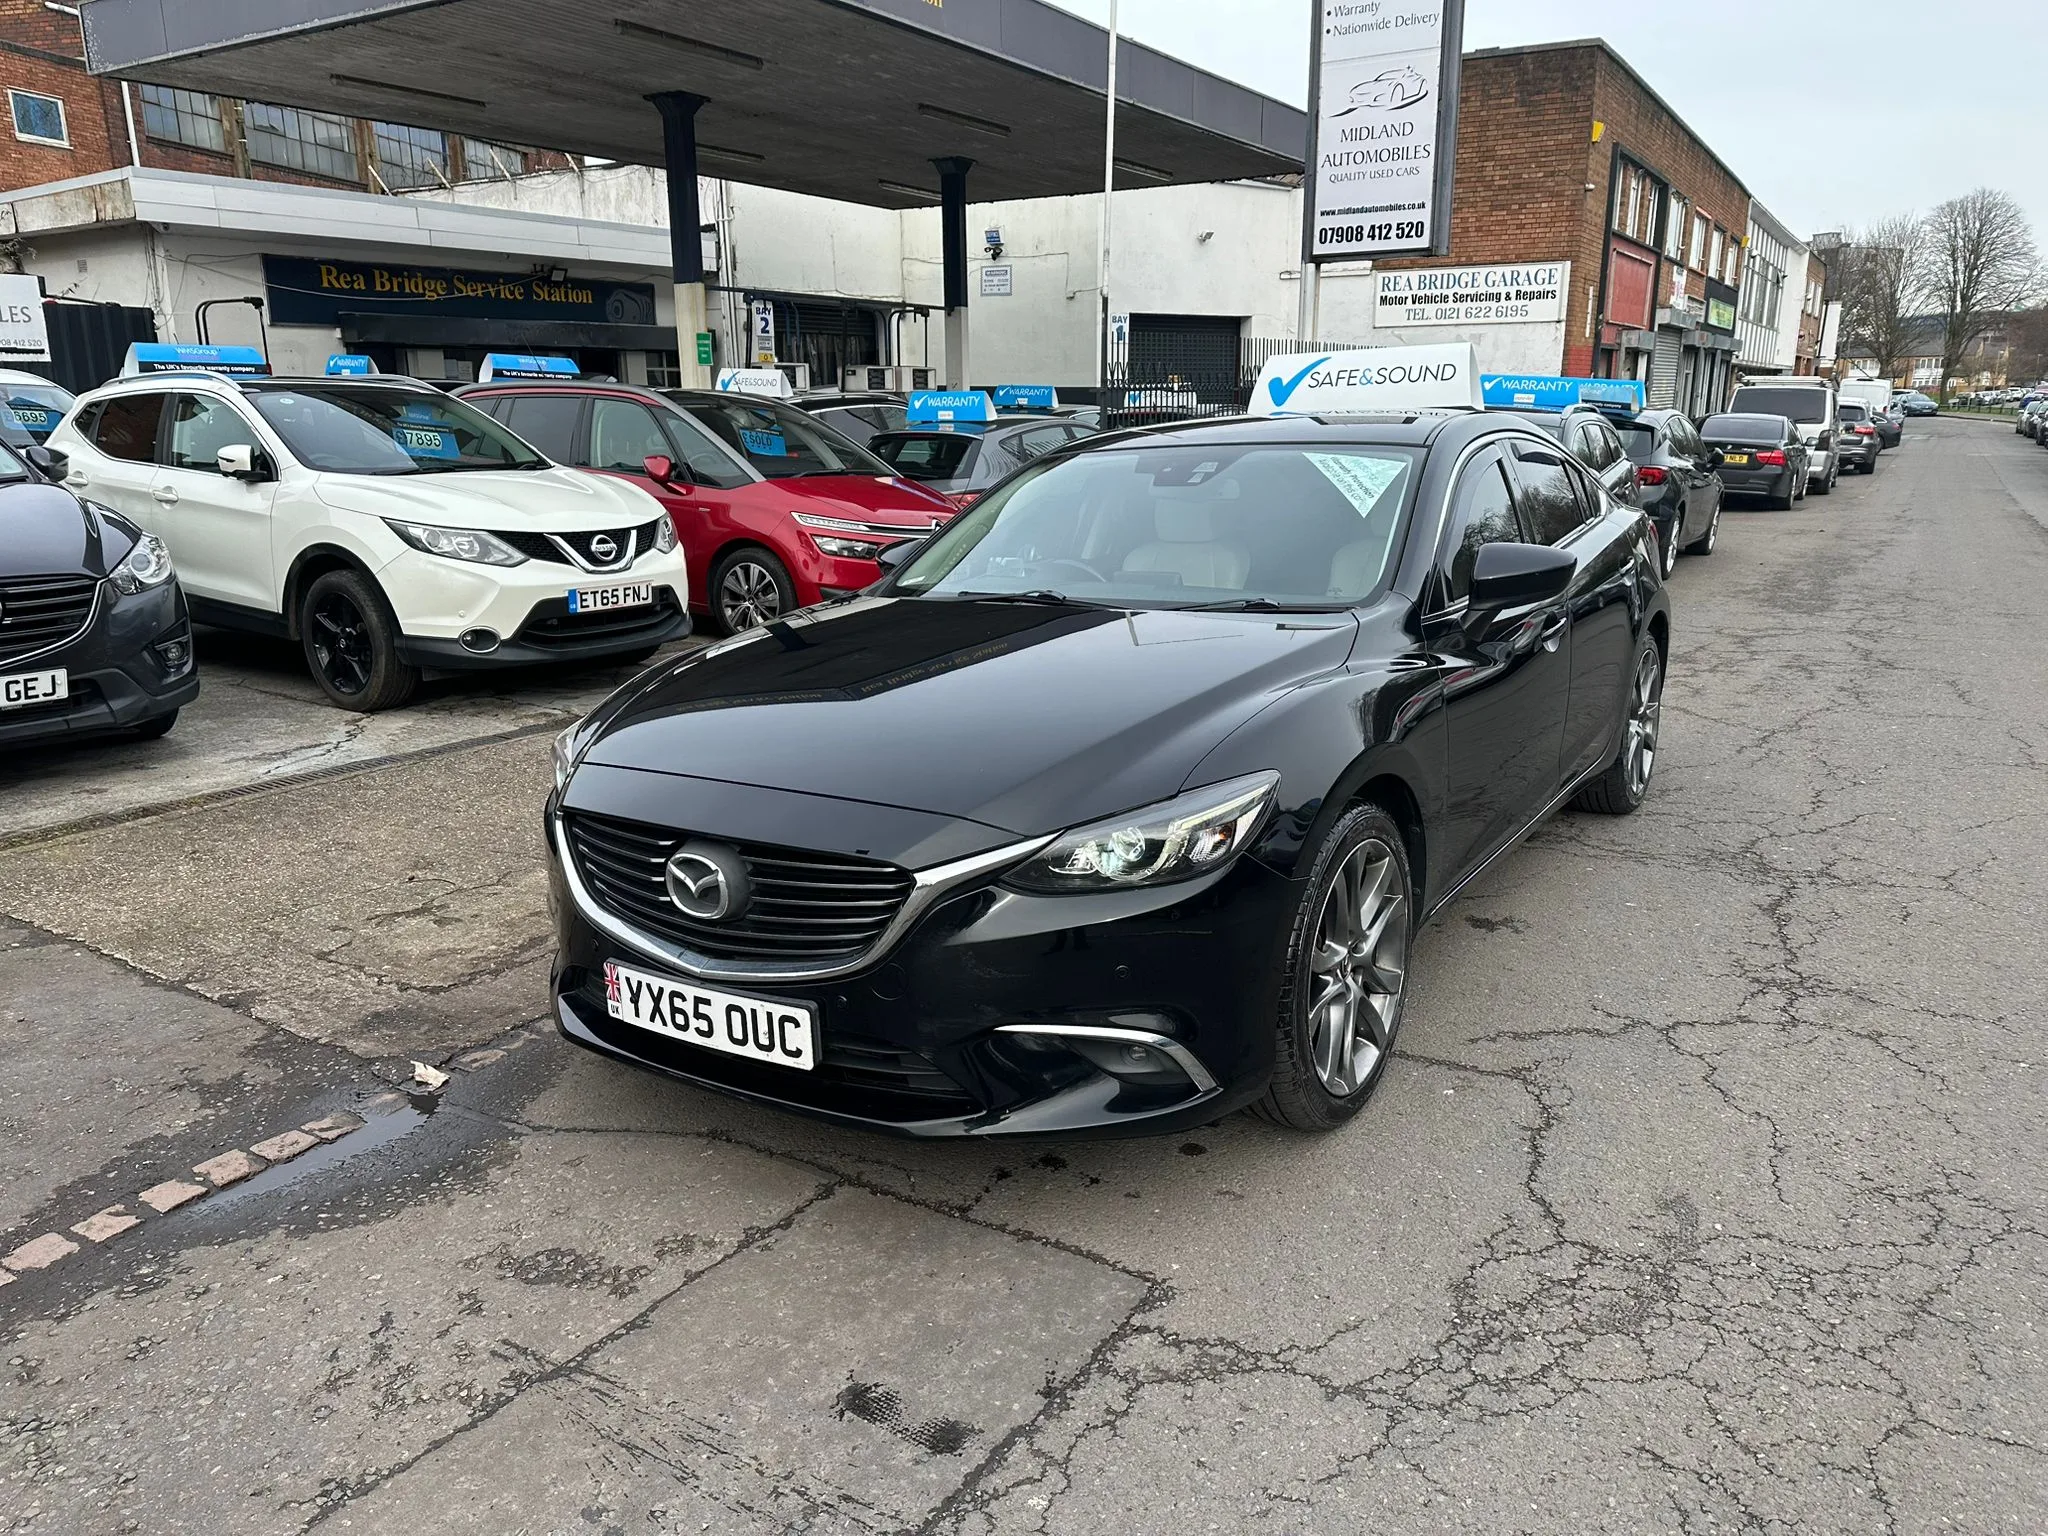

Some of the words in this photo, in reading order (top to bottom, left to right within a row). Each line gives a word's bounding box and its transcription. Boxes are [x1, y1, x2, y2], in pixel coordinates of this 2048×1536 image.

[1334, 1, 1381, 17] Warranty
[1333, 17, 1392, 37] Nationwide
[1394, 12, 1440, 27] Delivery
[1340, 121, 1414, 142] MIDLAND
[1321, 144, 1430, 168] AUTOMOBILES
[1329, 170, 1368, 183] QUALITY
[1369, 168, 1394, 179] USED
[1396, 166, 1420, 177] CARS
[1320, 201, 1426, 217] www.midlandautomobiles.co.uk
[1319, 225, 1364, 244] 07908
[1367, 223, 1392, 241] 412
[1395, 221, 1425, 239] 520
[321, 265, 366, 291] Rea
[373, 269, 448, 300] Bridge
[453, 275, 524, 300] Service
[532, 281, 593, 304] Station
[1381, 275, 1413, 292] REA
[1417, 271, 1480, 291] BRIDGE
[1485, 268, 1558, 288] GARAGE
[1380, 294, 1409, 306] Motor
[1411, 292, 1449, 305] Vehicle
[1452, 290, 1501, 304] Servicing
[1505, 292, 1512, 301] &
[1515, 289, 1557, 302] Repairs
[756, 307, 771, 315] BAY
[1405, 308, 1431, 321] TEL.
[1435, 307, 1460, 320] 0121
[1465, 306, 1491, 319] 622
[1495, 304, 1529, 318] 6195
[760, 317, 770, 334] 2
[1116, 325, 1123, 341] 1
[13, 339, 26, 347] 412
[337, 359, 365, 367] WARRANTY
[733, 377, 778, 387] SAFE&SOUND
[1308, 363, 1457, 388] SAFE&SOUND
[1009, 388, 1050, 396] WARRANTY
[1502, 379, 1573, 392] WARRANTY
[927, 396, 981, 407] WARRANTY
[580, 588, 619, 608] ET65
[623, 584, 649, 603] FNJ
[5, 675, 56, 702] GEJ
[610, 1004, 621, 1016] UK
[625, 976, 714, 1039] YX65
[725, 1003, 803, 1059] OUC
